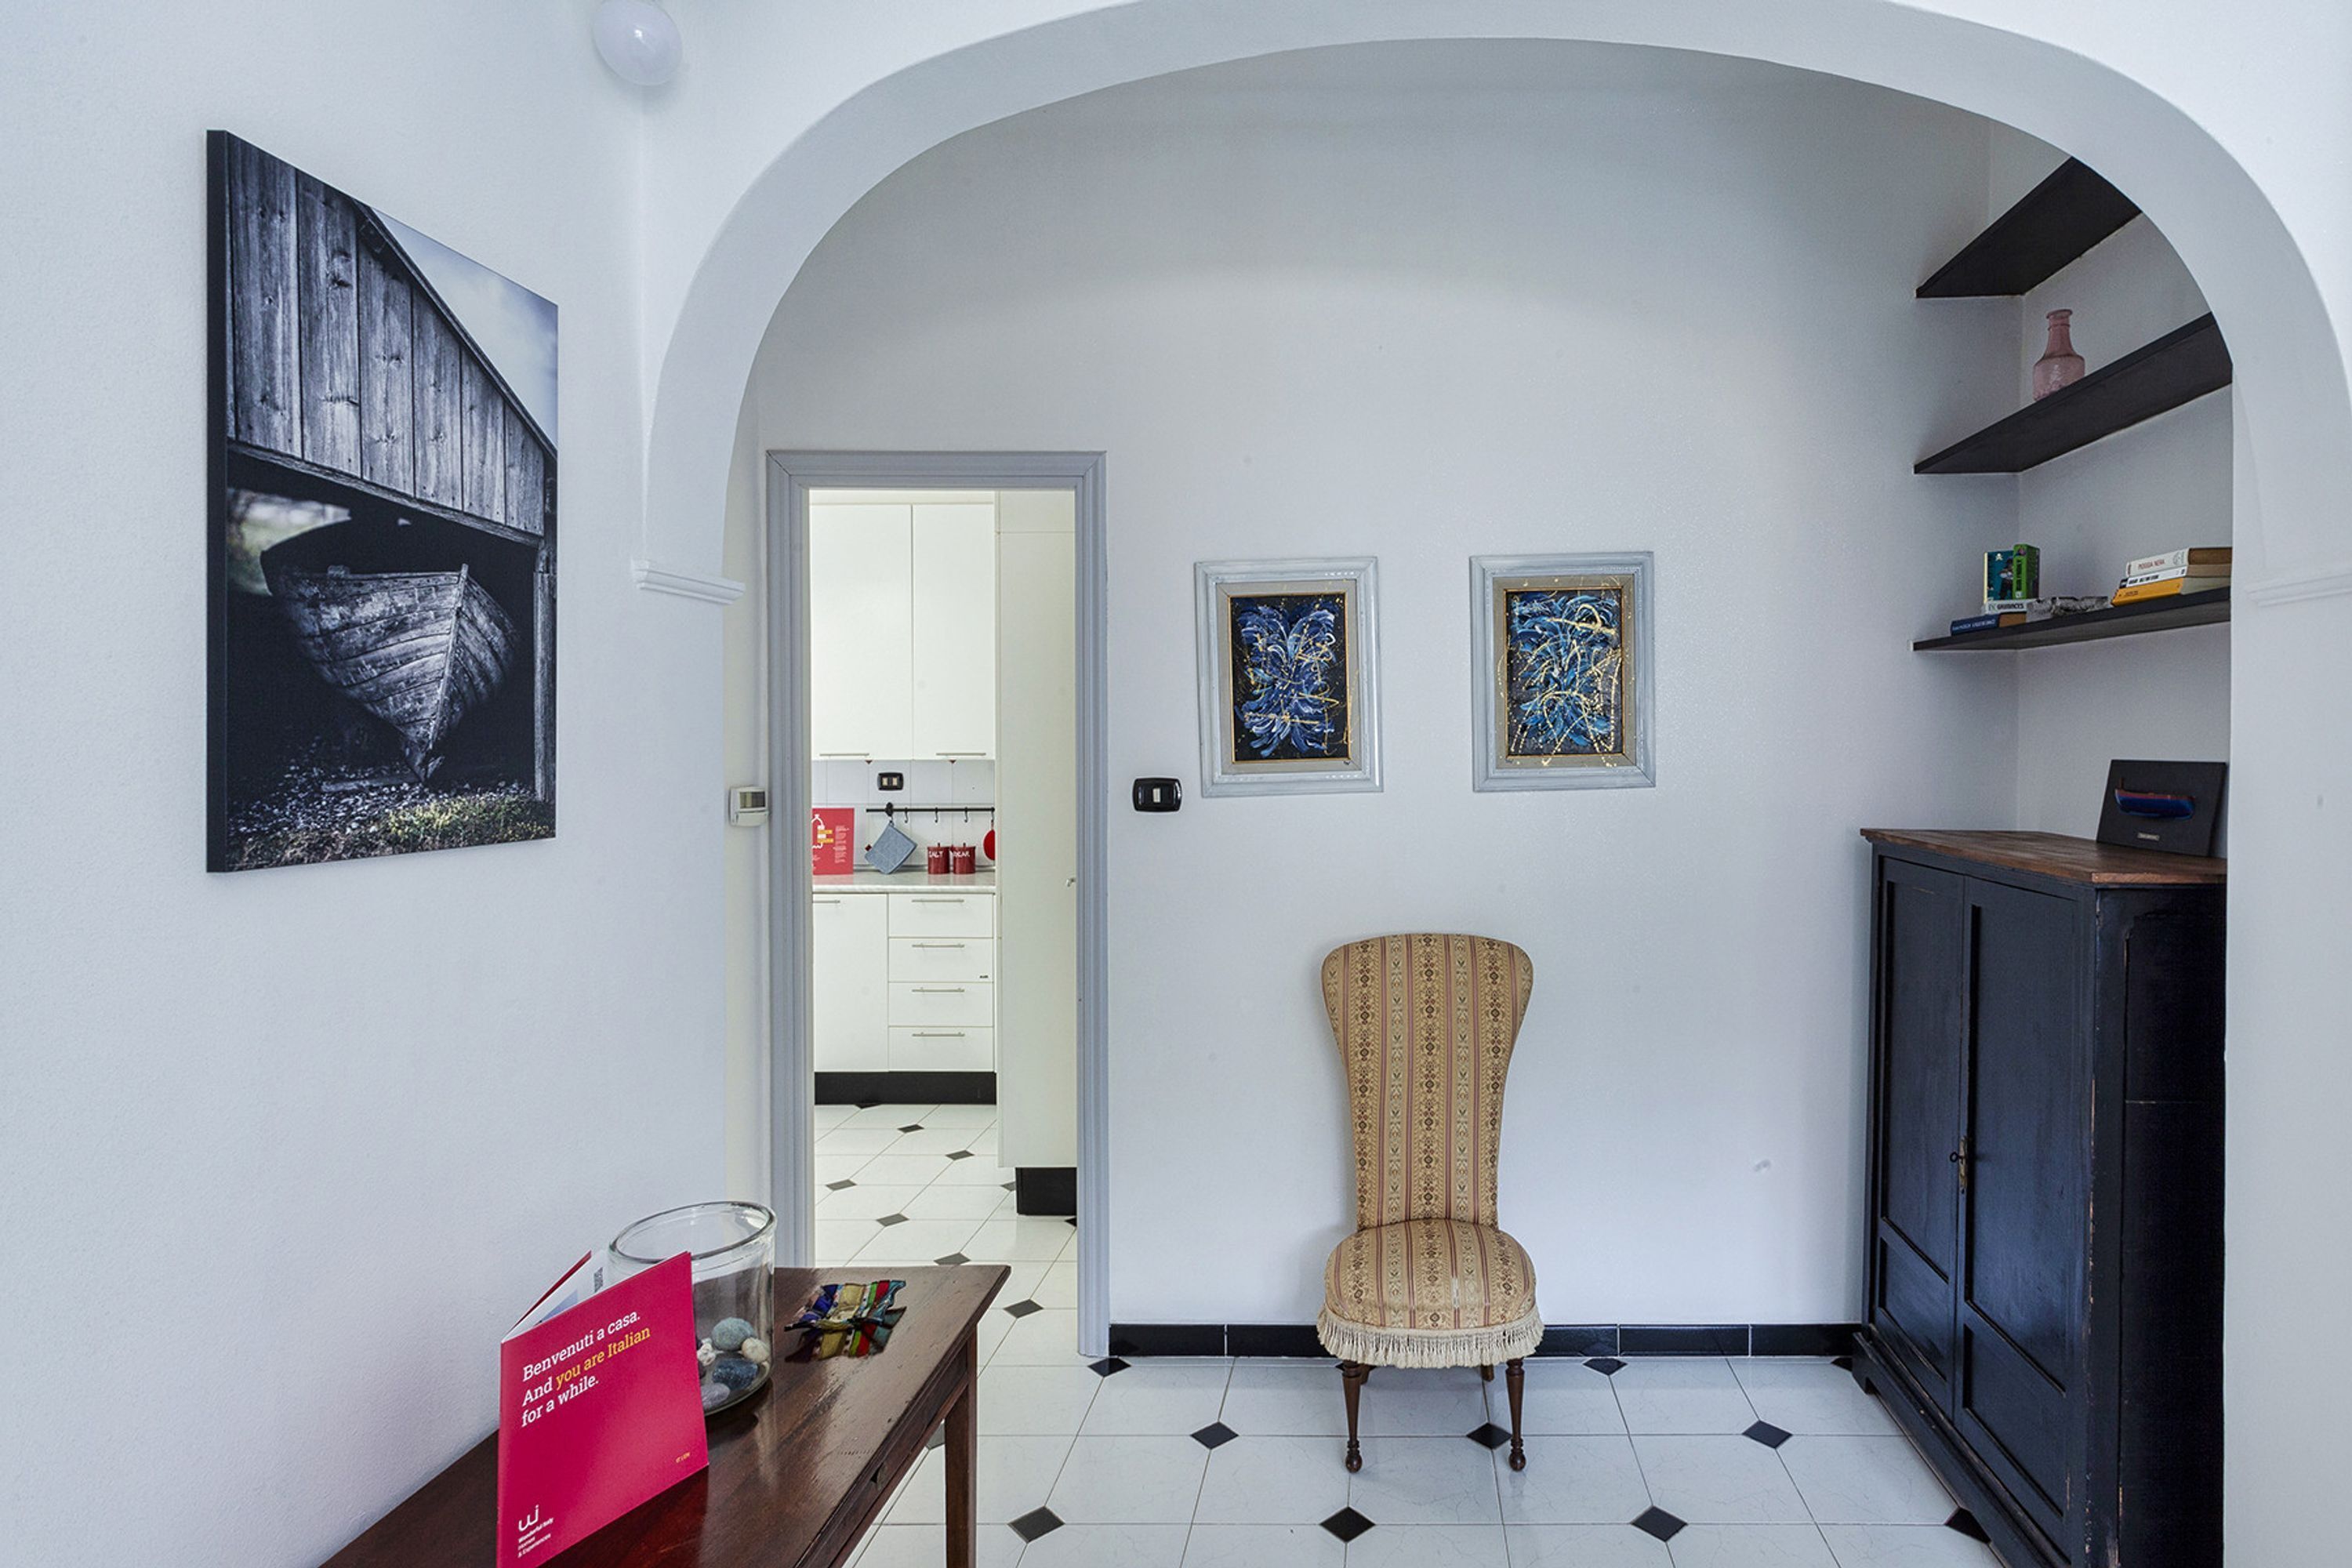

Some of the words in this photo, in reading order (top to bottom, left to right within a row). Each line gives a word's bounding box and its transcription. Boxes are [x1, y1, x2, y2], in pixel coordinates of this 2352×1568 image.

[521, 1376, 554, 1407] And
[555, 1364, 581, 1391] you
[583, 1351, 605, 1371] are
[608, 1327, 652, 1359] Italian
[522, 1330, 594, 1382] Benvenuti
[597, 1328, 605, 1341] a
[607, 1311, 641, 1334] casa.
[521, 1405, 543, 1428] for
[546, 1399, 555, 1413] a
[557, 1375, 599, 1405] while.
